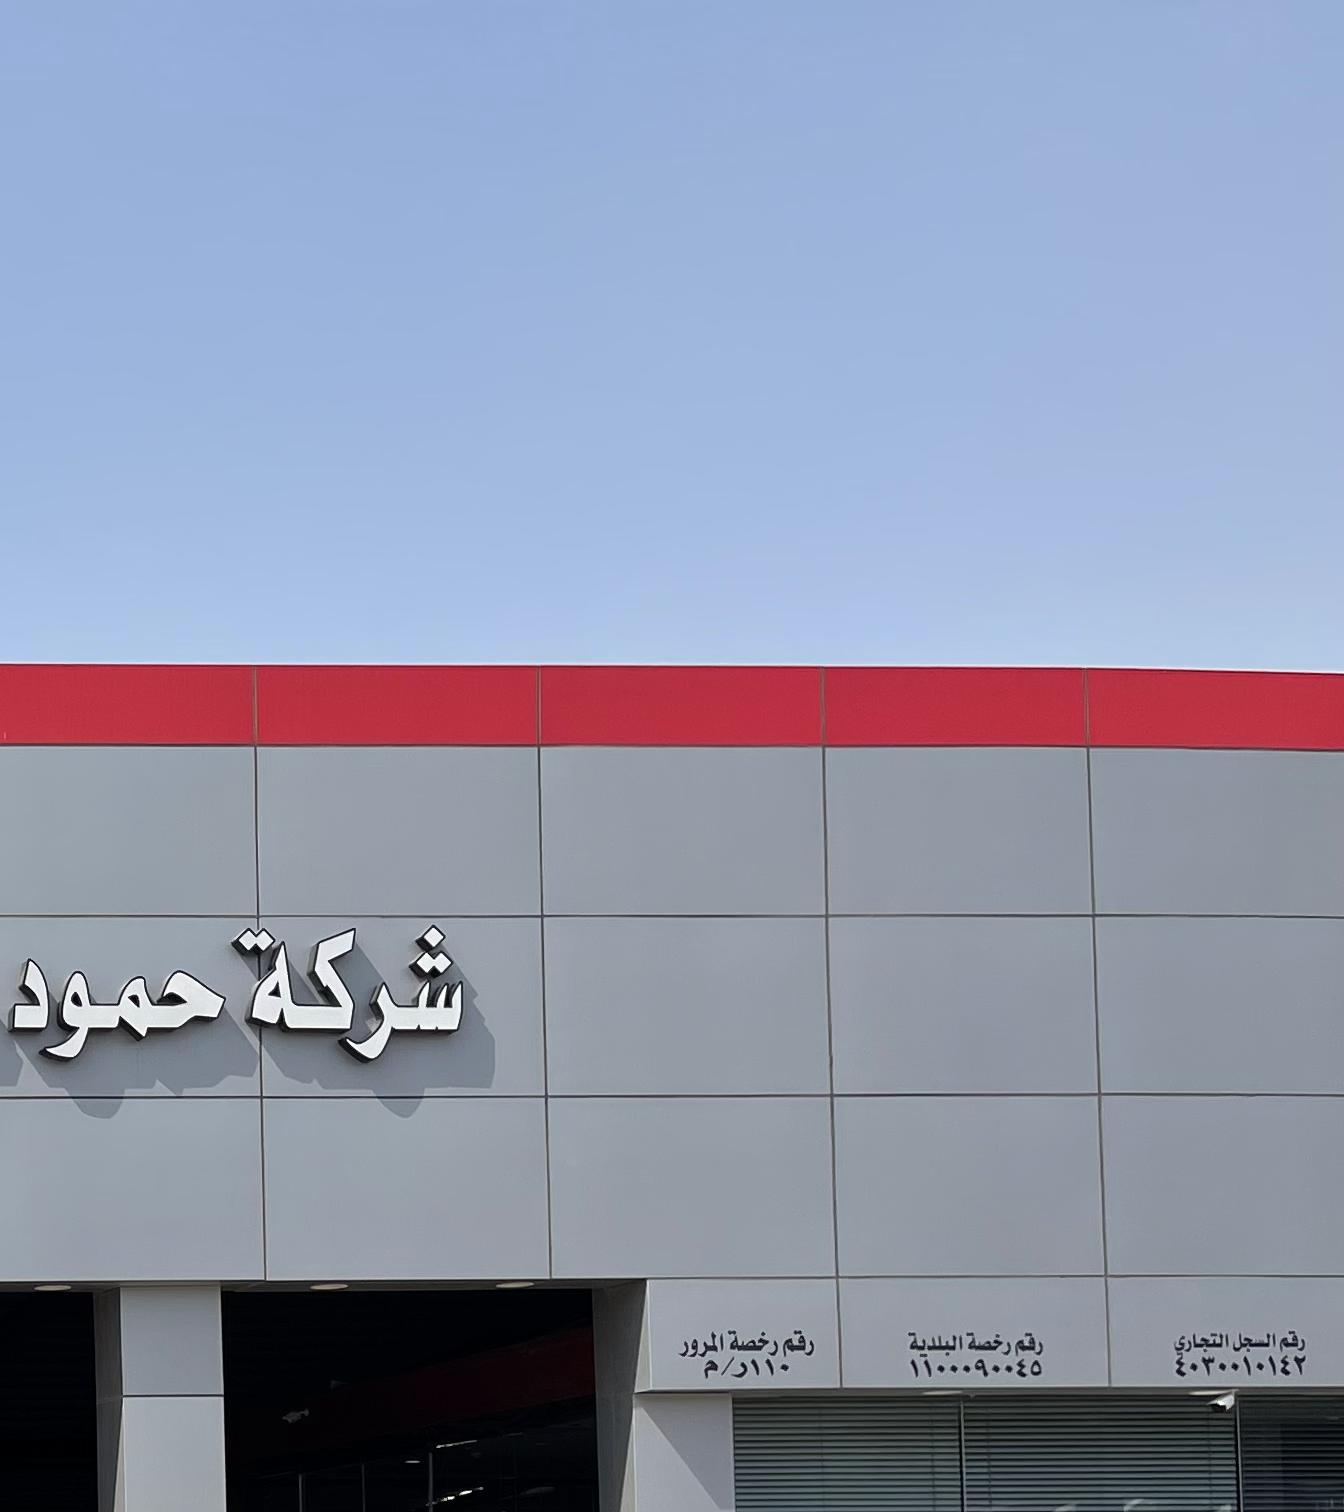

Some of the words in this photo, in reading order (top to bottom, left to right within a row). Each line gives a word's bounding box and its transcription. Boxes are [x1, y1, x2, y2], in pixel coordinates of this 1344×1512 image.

[231, 923, 465, 1064] شركة
[9, 957, 228, 1061] حمود
[678, 1330, 724, 1358] المرور
[727, 1330, 779, 1357] رخصة
[782, 1329, 815, 1357] رقم
[907, 1331, 964, 1358] البلدية
[966, 1332, 1012, 1356] رخصة
[1014, 1332, 1044, 1356] رقم
[1173, 1333, 1229, 1357] التجاري
[1232, 1333, 1276, 1353] السجل
[1279, 1330, 1306, 1352] رقم
[909, 1358, 1043, 1378] ١١٠٠٠٩٠٠٤٥
[1174, 1354, 1306, 1377] ٤٠٣٠٠١٠١٤٢
